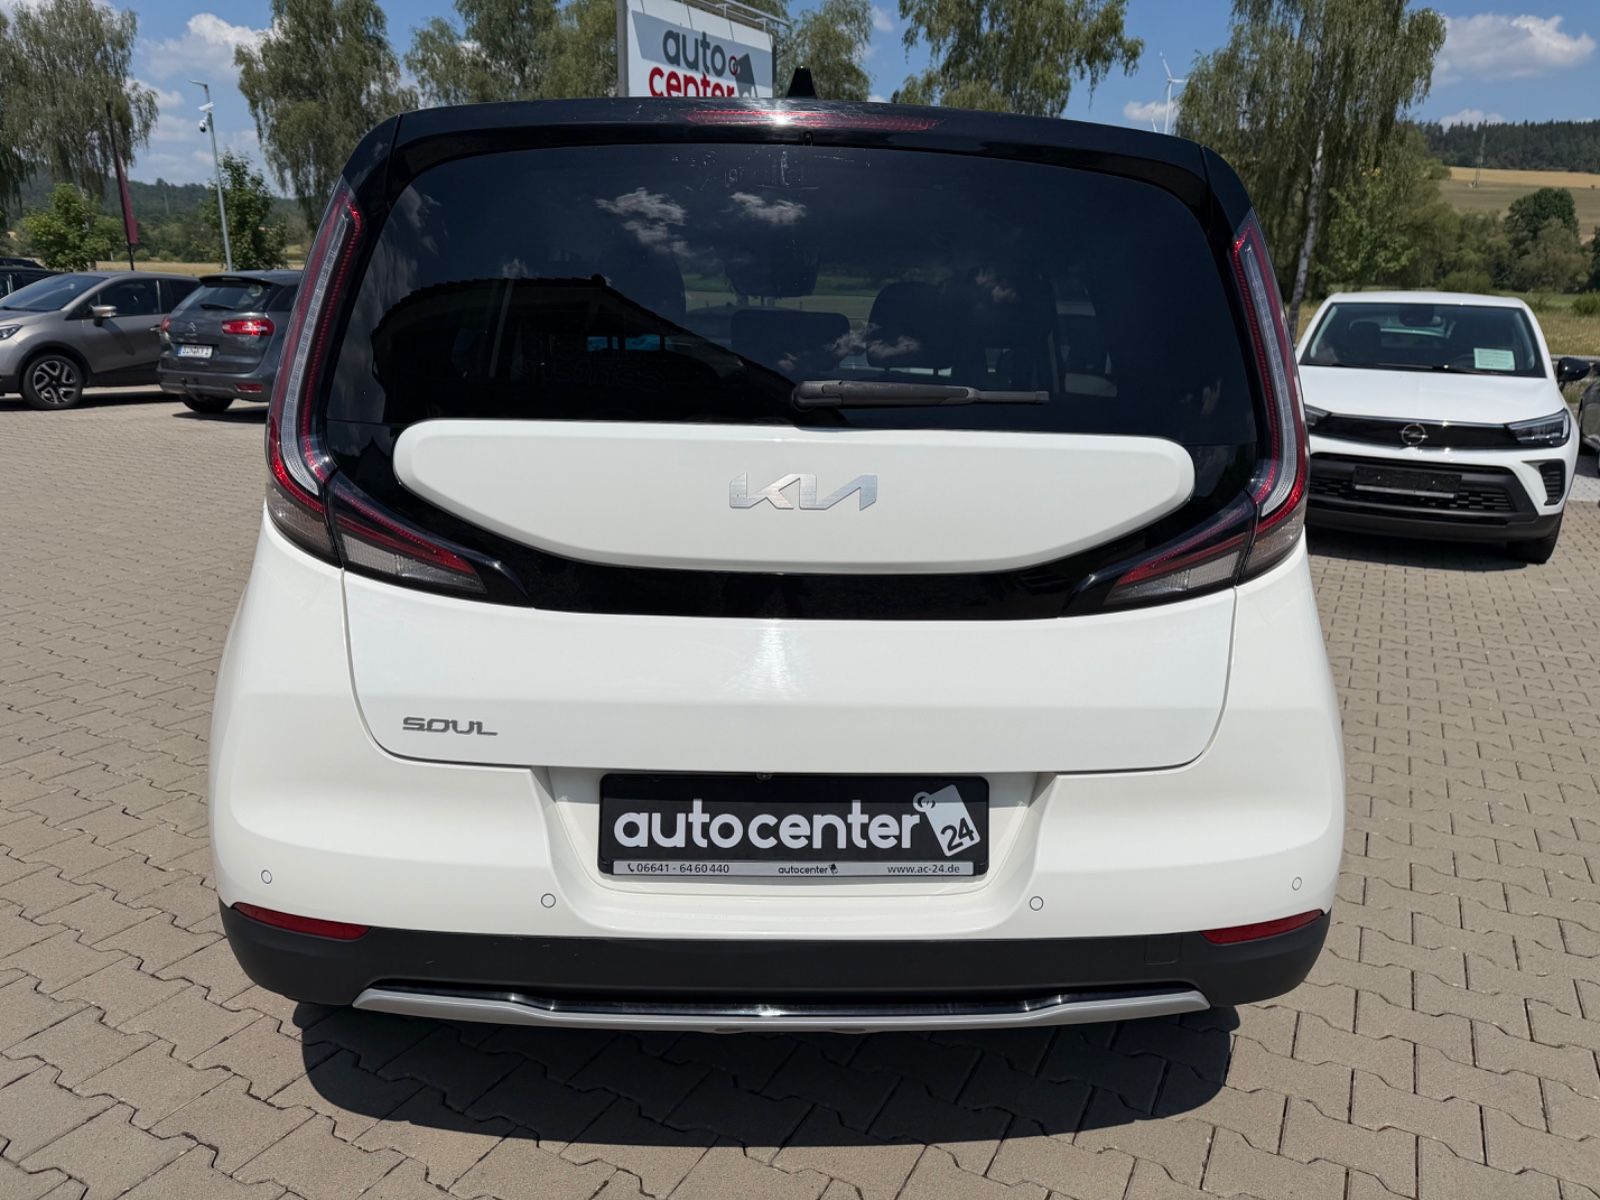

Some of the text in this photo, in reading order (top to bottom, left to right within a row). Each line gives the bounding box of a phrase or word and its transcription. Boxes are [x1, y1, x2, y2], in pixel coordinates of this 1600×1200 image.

[663, 30, 726, 77] auto
[729, 472, 878, 511] KIA
[402, 716, 498, 736] SOUL
[941, 817, 975, 852] 24
[636, 863, 669, 873] 06641
[778, 864, 829, 875] autocenter
[887, 864, 960, 874] www.ac-24.de
